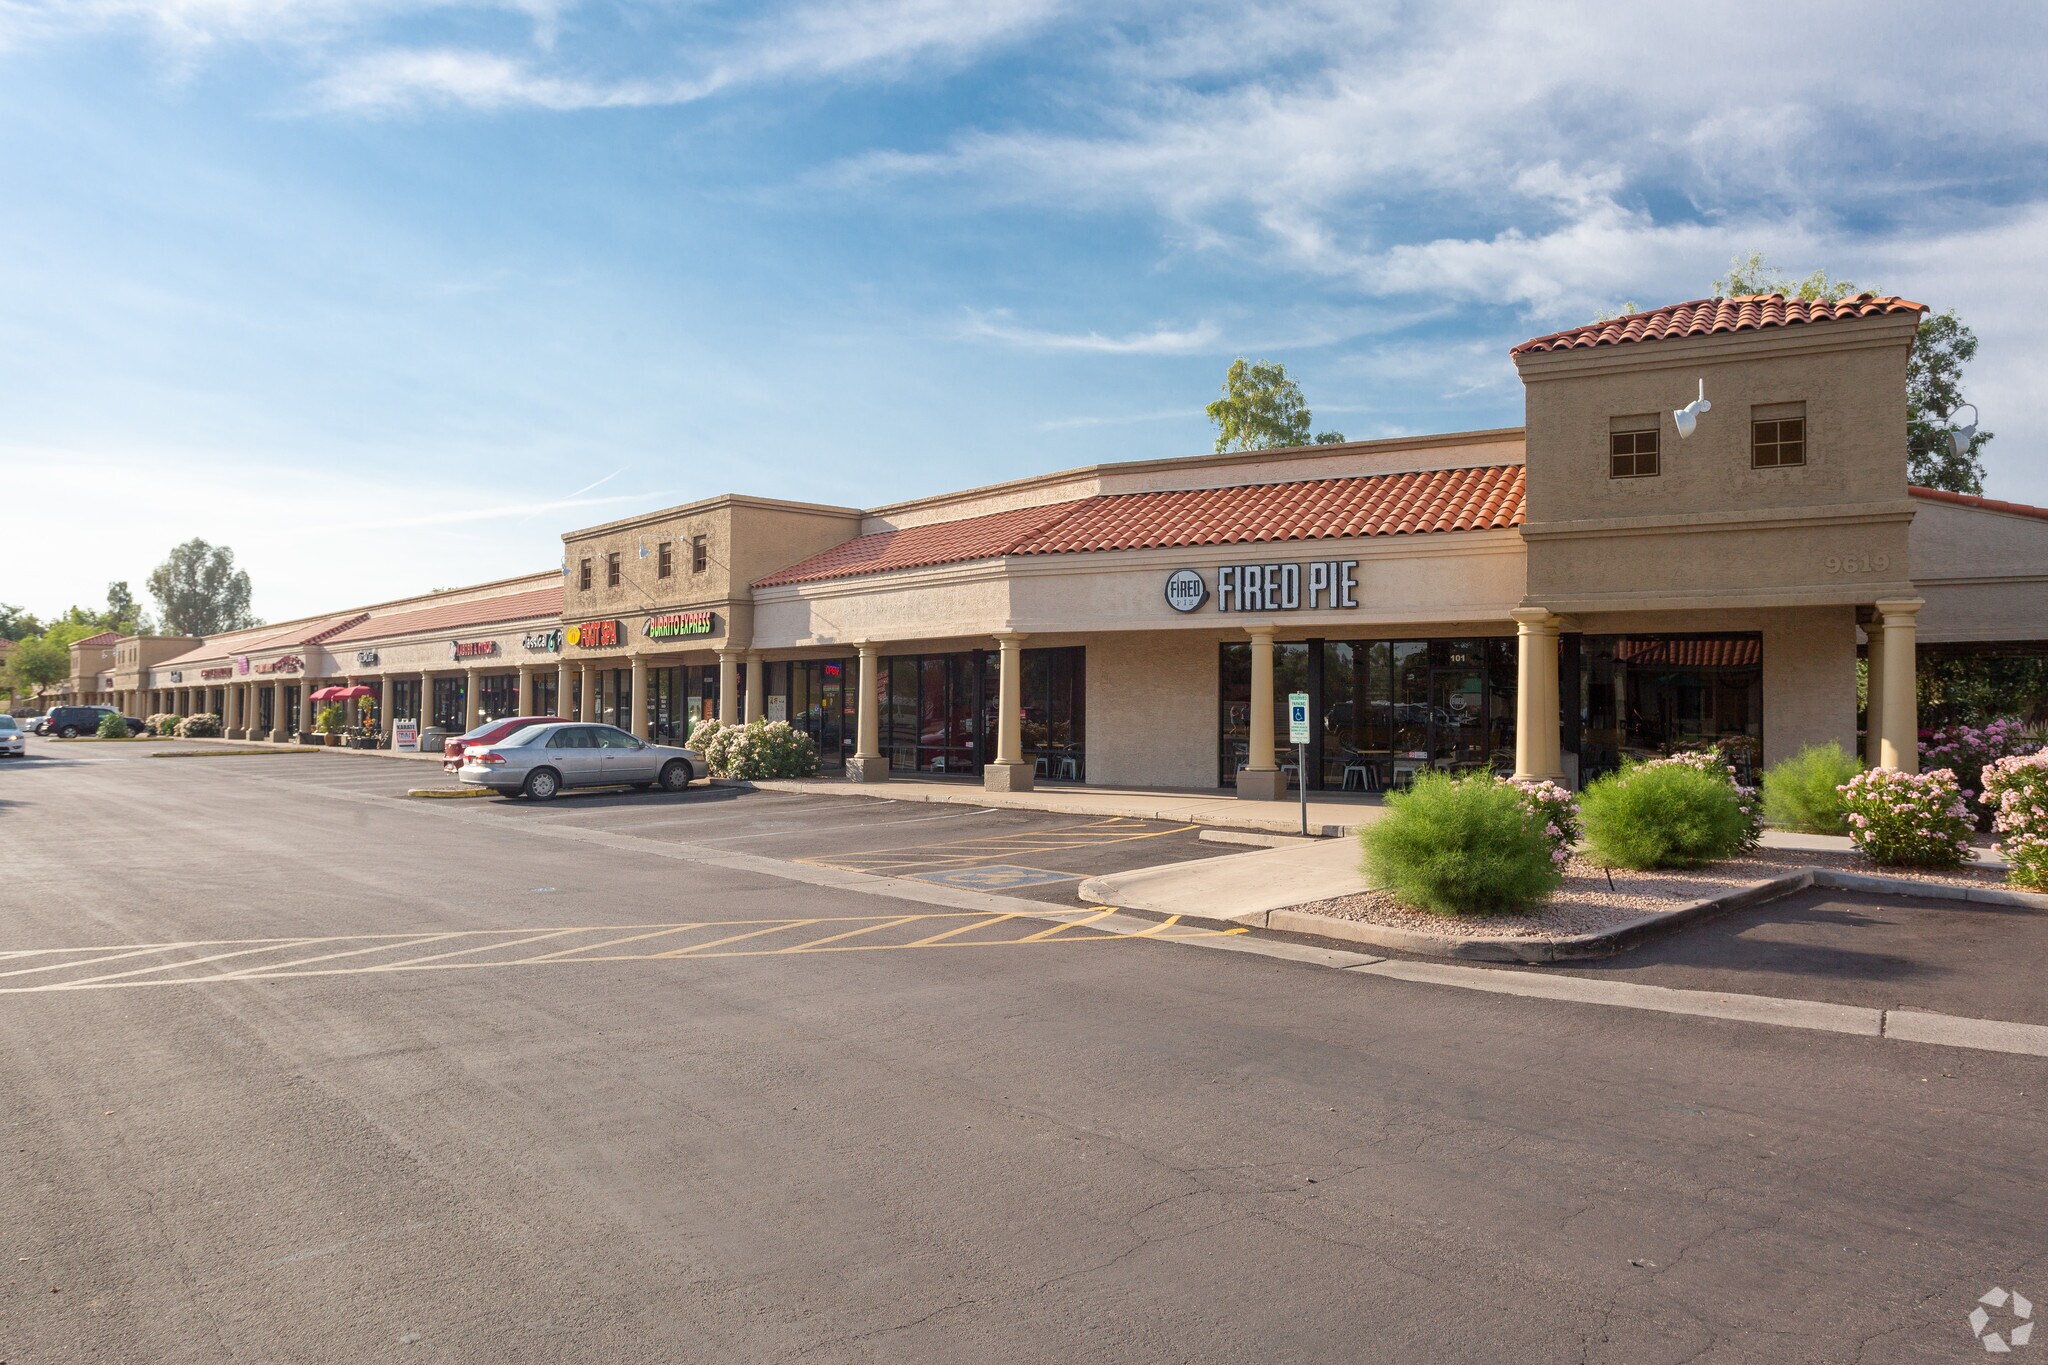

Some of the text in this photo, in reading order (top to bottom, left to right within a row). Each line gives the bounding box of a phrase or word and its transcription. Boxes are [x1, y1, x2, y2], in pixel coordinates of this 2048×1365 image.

[1824, 553, 1890, 574] 9619
[1170, 575, 1200, 598] FIRED
[1218, 560, 1359, 612] FIRED PIE
[581, 619, 617, 648] FOOT SPA
[650, 612, 711, 638] BURRITO EXPRESS
[1450, 654, 1466, 662] 101
[825, 665, 840, 676] OPEN
